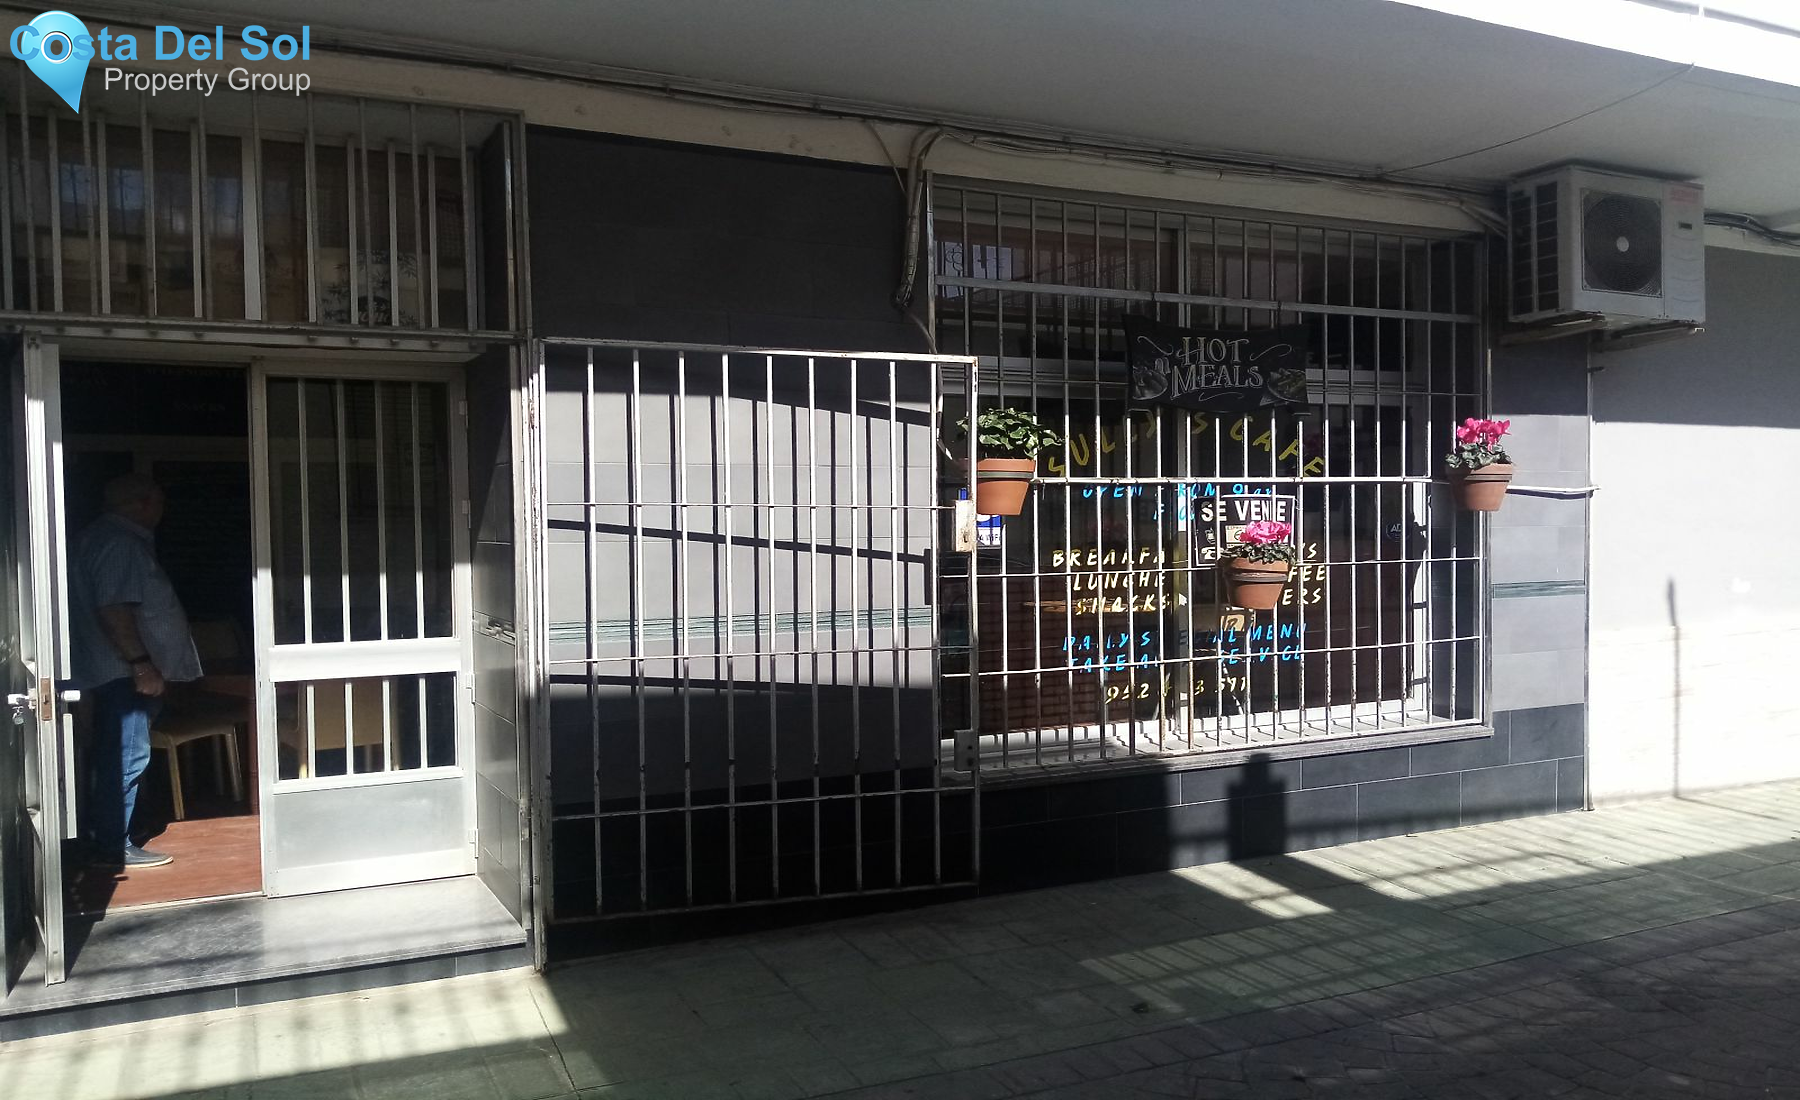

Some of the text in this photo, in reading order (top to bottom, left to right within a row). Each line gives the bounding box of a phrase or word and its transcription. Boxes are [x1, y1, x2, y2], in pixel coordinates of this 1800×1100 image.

[1176, 336, 1250, 366] HOT
[1171, 365, 1264, 400] MEALS
[1201, 501, 1227, 522] SE
[1234, 500, 1287, 522] VENE
